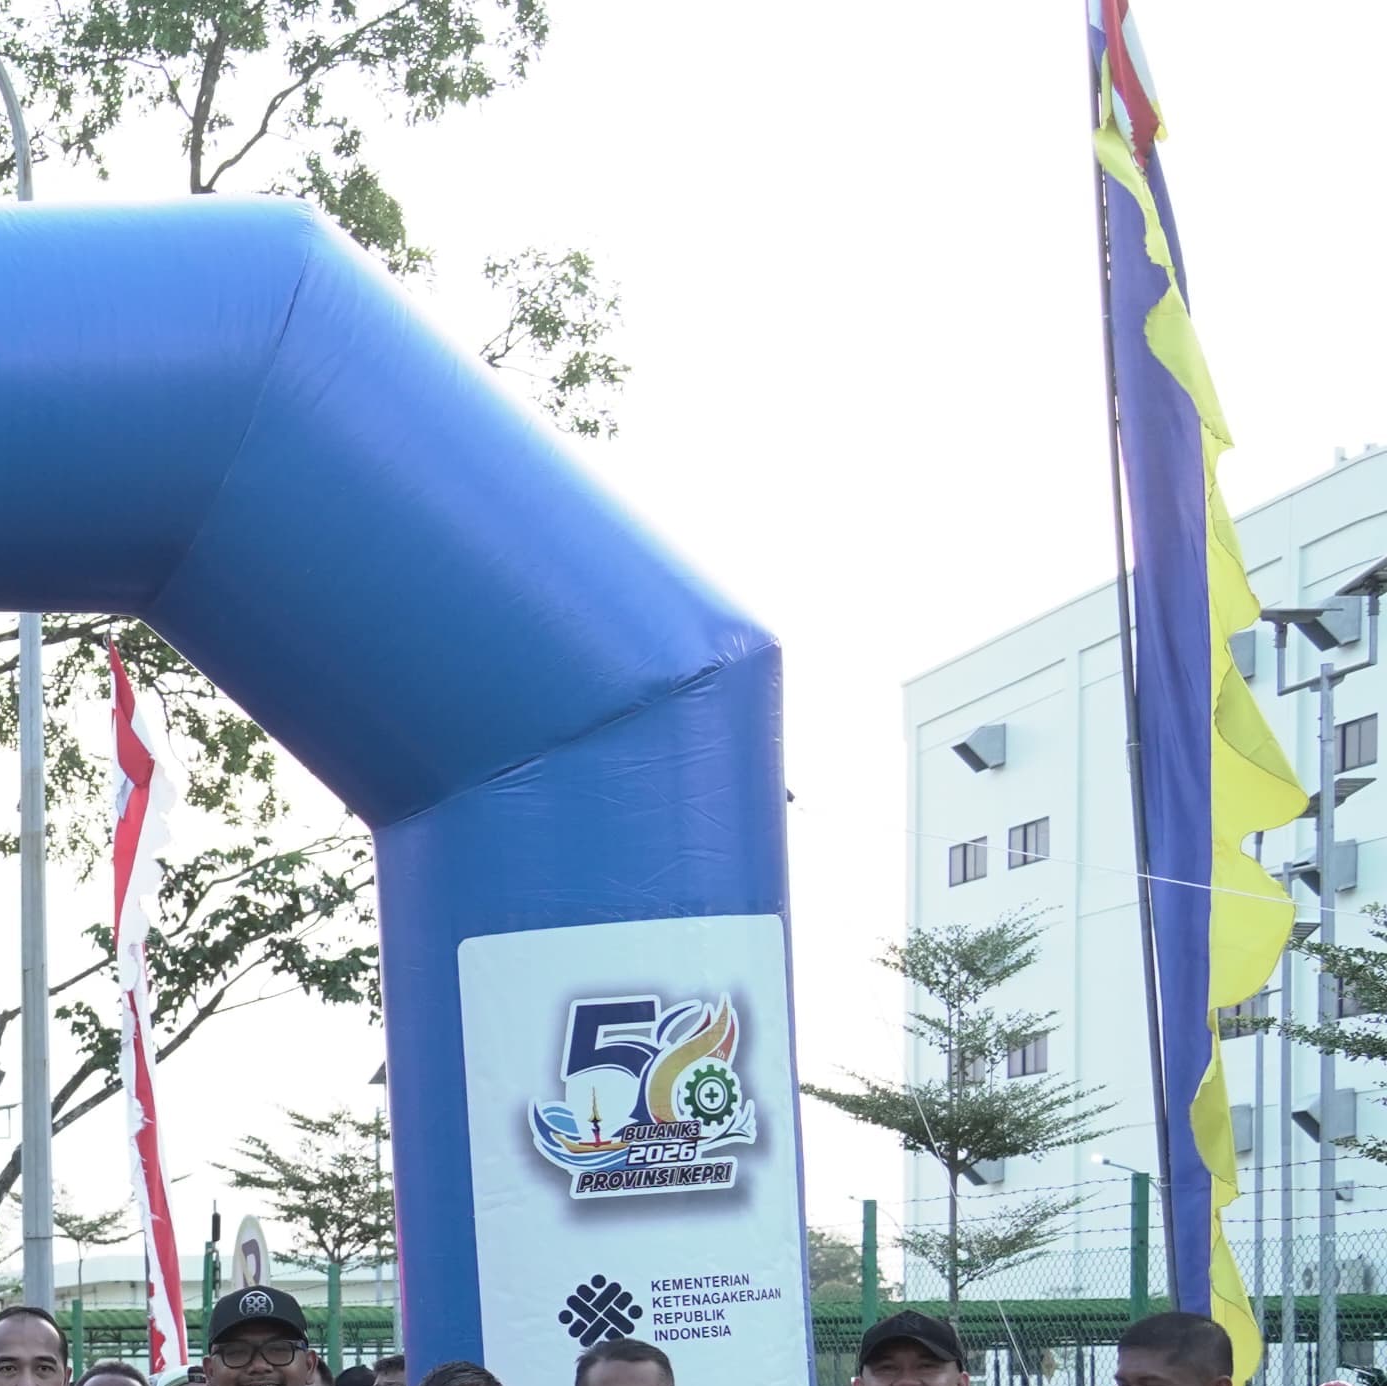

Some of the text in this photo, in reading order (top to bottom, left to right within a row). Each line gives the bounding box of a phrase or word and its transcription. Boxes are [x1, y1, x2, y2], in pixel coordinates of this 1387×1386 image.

[624, 1121, 700, 1143] BULAN K3
[628, 1143, 697, 1164] 2026
[578, 1163, 733, 1192] PROVINSI KEPRI
[651, 1274, 750, 1292] KEMENTERIAN
[652, 1288, 782, 1308] KETENAGAKERJAAN
[653, 1309, 725, 1325] REPUBLIK
[654, 1325, 732, 1341] INDONESIA
